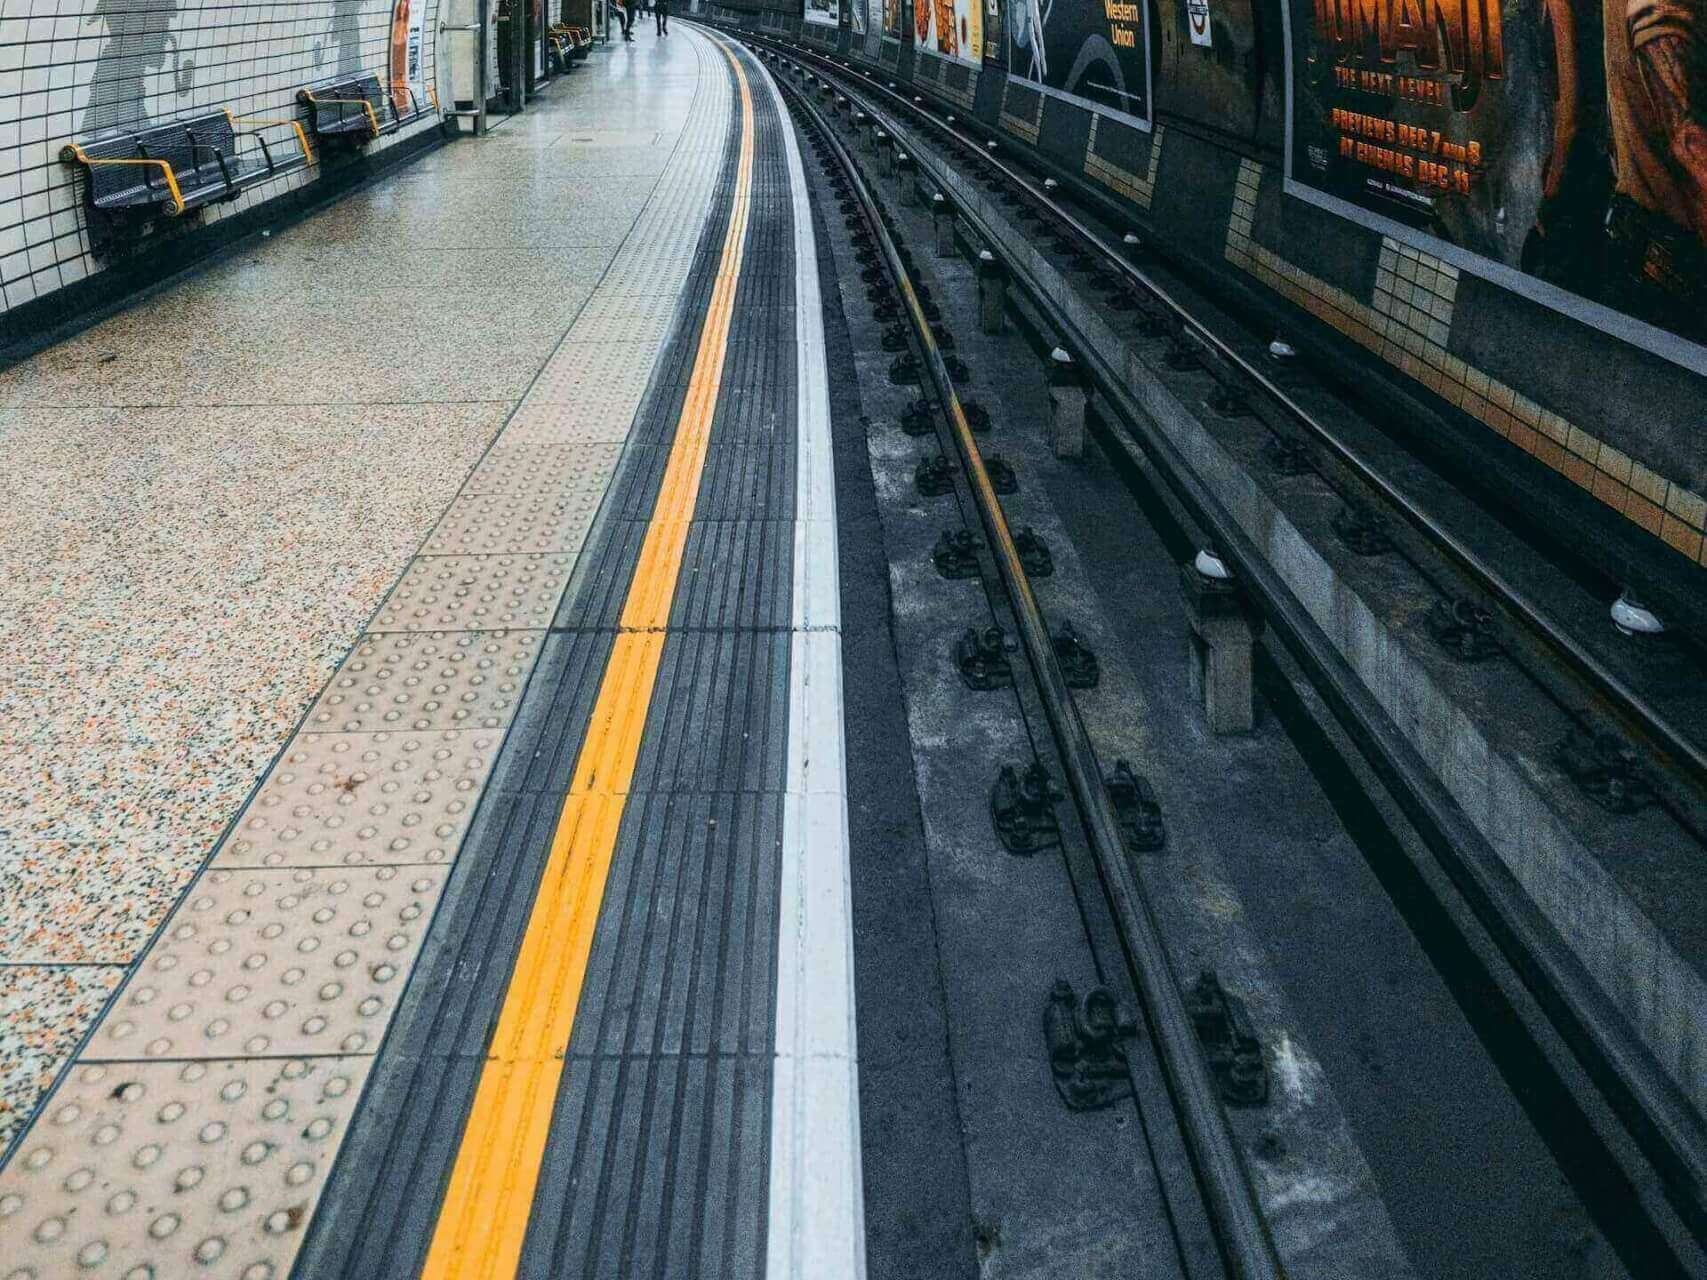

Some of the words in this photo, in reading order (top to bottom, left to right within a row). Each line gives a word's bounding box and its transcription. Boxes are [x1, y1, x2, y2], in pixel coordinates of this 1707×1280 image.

[1104, 0, 1139, 23] Western
[1111, 23, 1135, 48] Union
[1335, 66, 1357, 90] THE
[1331, 107, 1395, 143] PREVIEWS
[1399, 123, 1429, 150] DEC
[1430, 131, 1441, 154] 7
[1467, 140, 1481, 166] 8
[1340, 136, 1354, 158] AT
[1356, 141, 1415, 177] CINEMAS
[1418, 159, 1449, 190] DEC
[1454, 170, 1472, 197] 11
